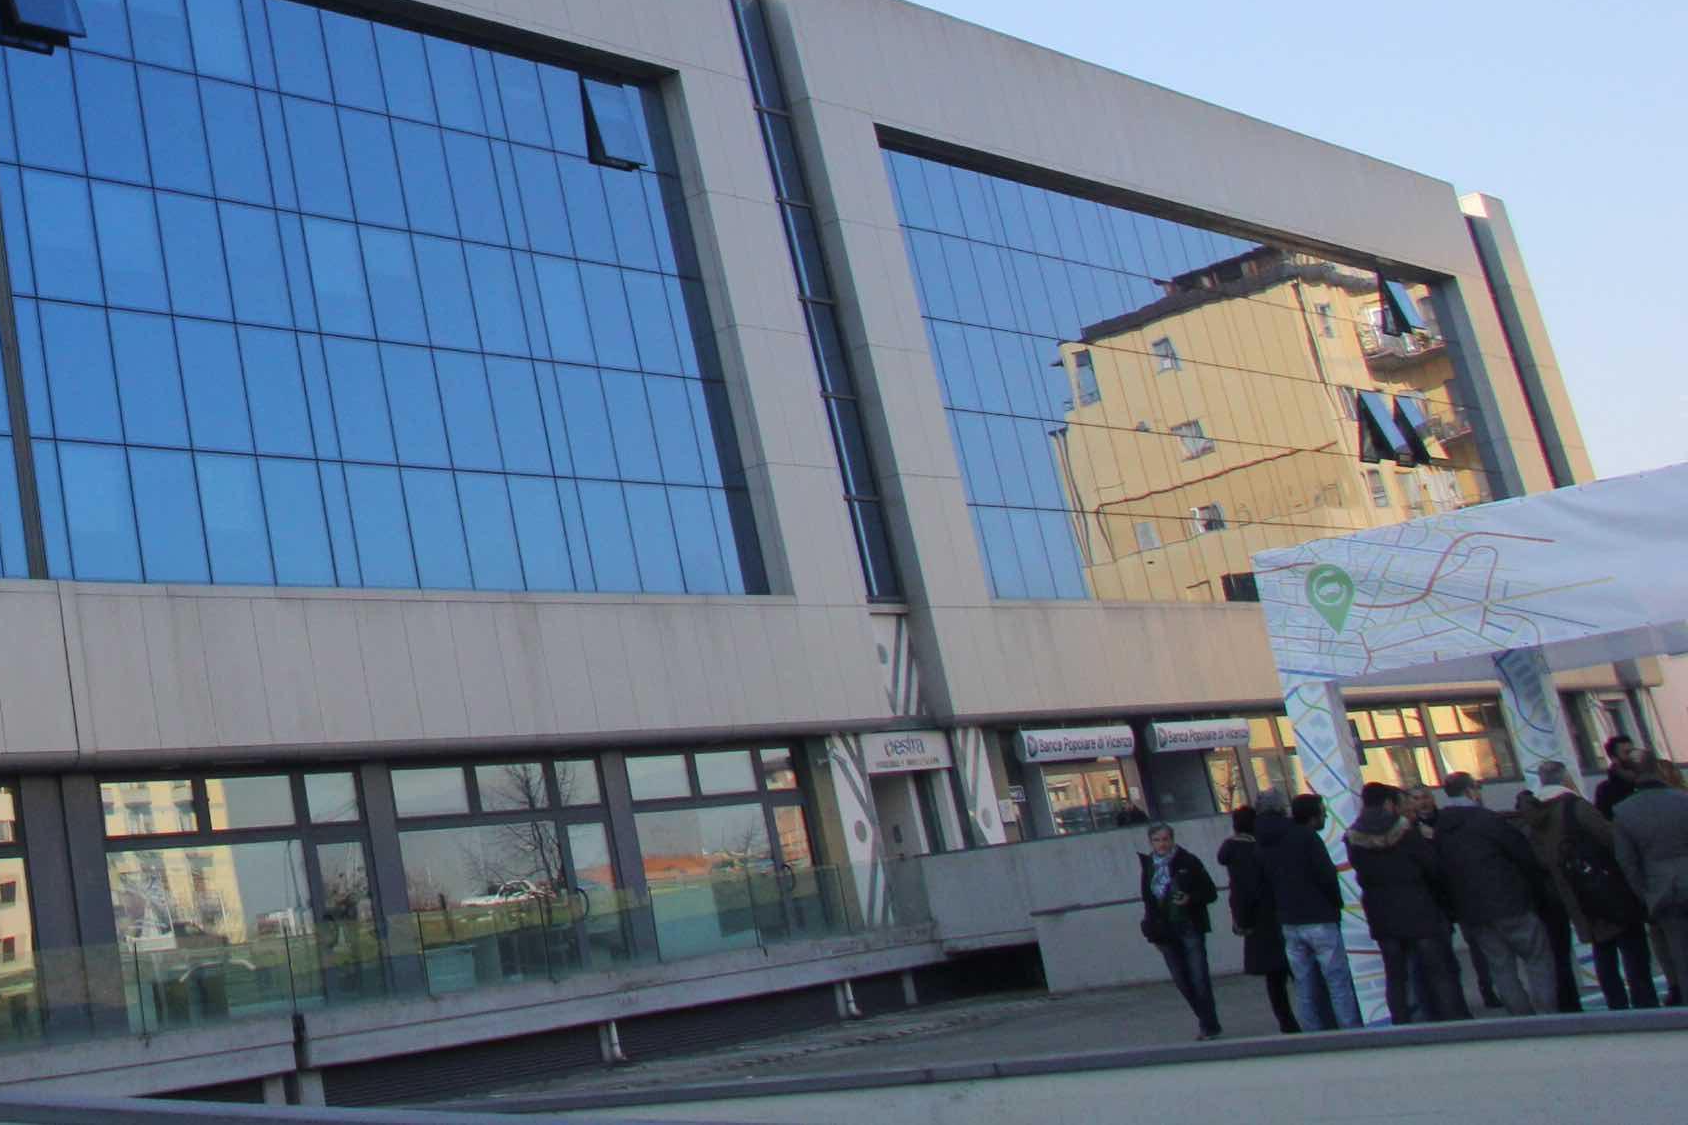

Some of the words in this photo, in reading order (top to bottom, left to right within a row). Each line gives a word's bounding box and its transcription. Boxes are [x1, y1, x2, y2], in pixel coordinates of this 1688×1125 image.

[1039, 738, 1062, 753] Banca
[1063, 736, 1096, 754] Popolare
[1097, 735, 1104, 749] di
[1105, 734, 1133, 748] Vicenza
